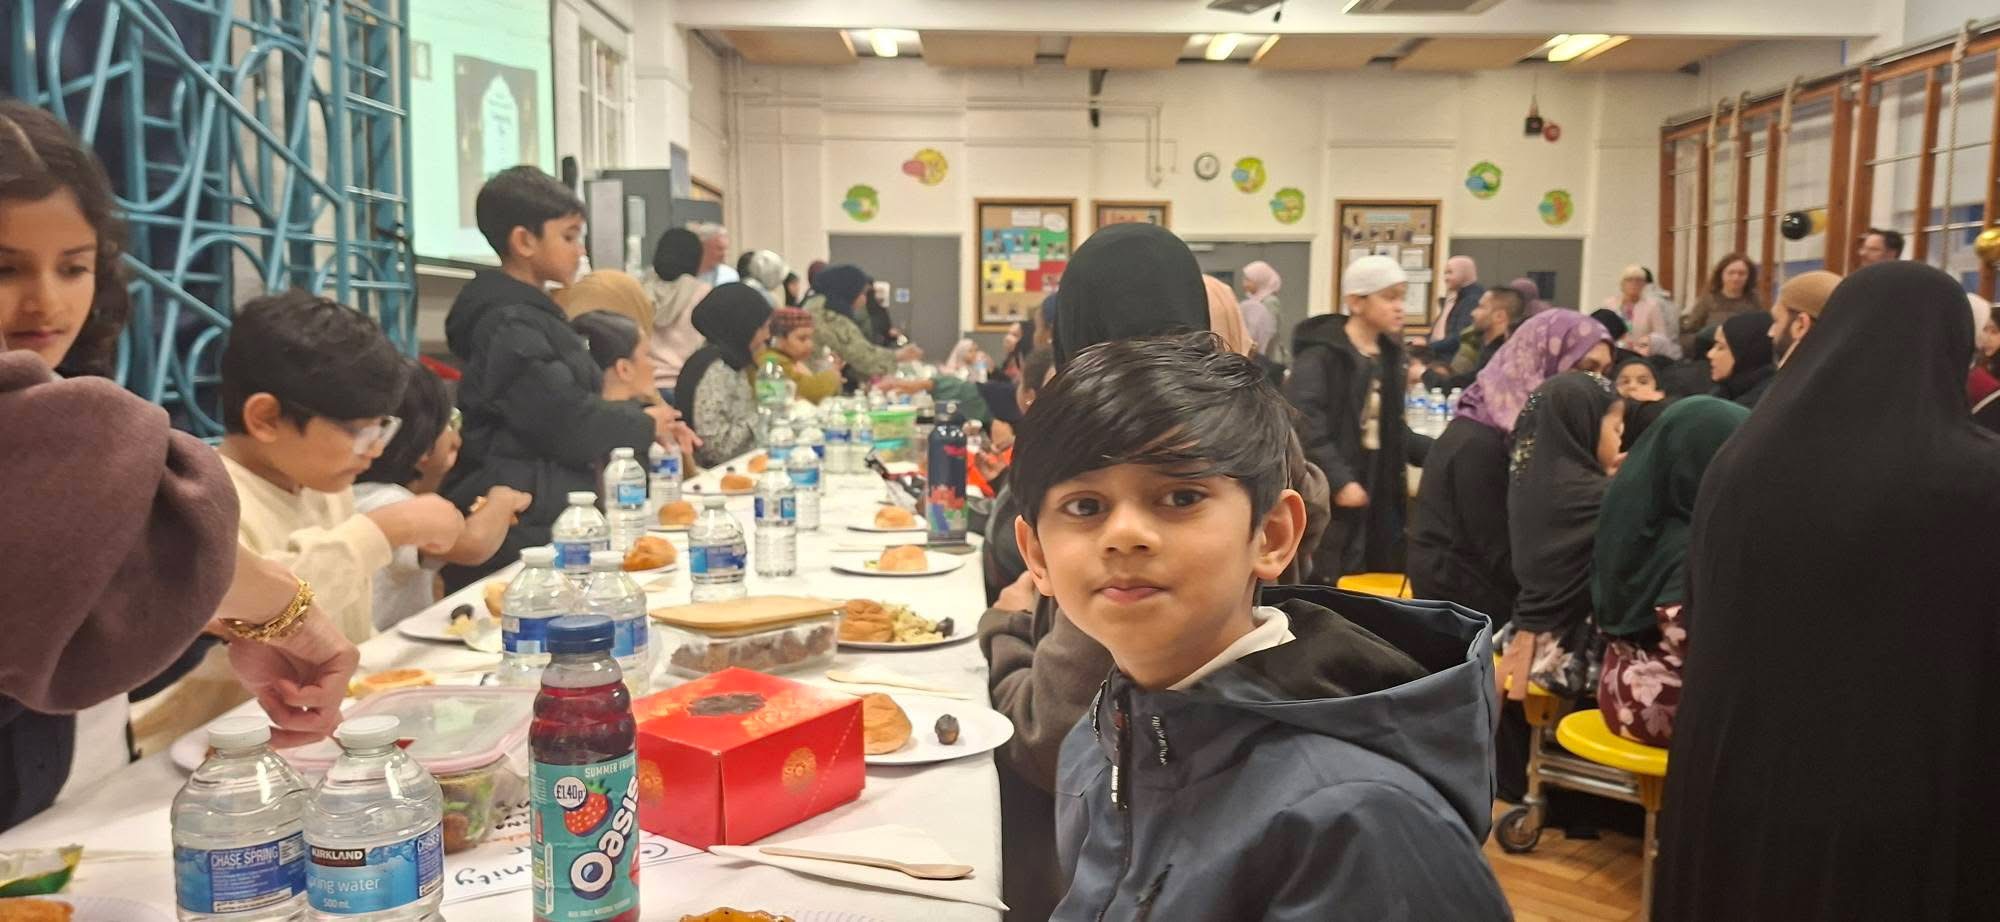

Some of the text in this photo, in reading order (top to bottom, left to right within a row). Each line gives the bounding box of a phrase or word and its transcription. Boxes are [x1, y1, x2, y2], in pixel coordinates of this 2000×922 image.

[584, 762, 617, 778] SUMMER
[210, 852, 242, 867] CHASE
[243, 845, 278, 864] SPRING
[311, 847, 363, 860] KIRKLAND
[337, 878, 381, 892] water
